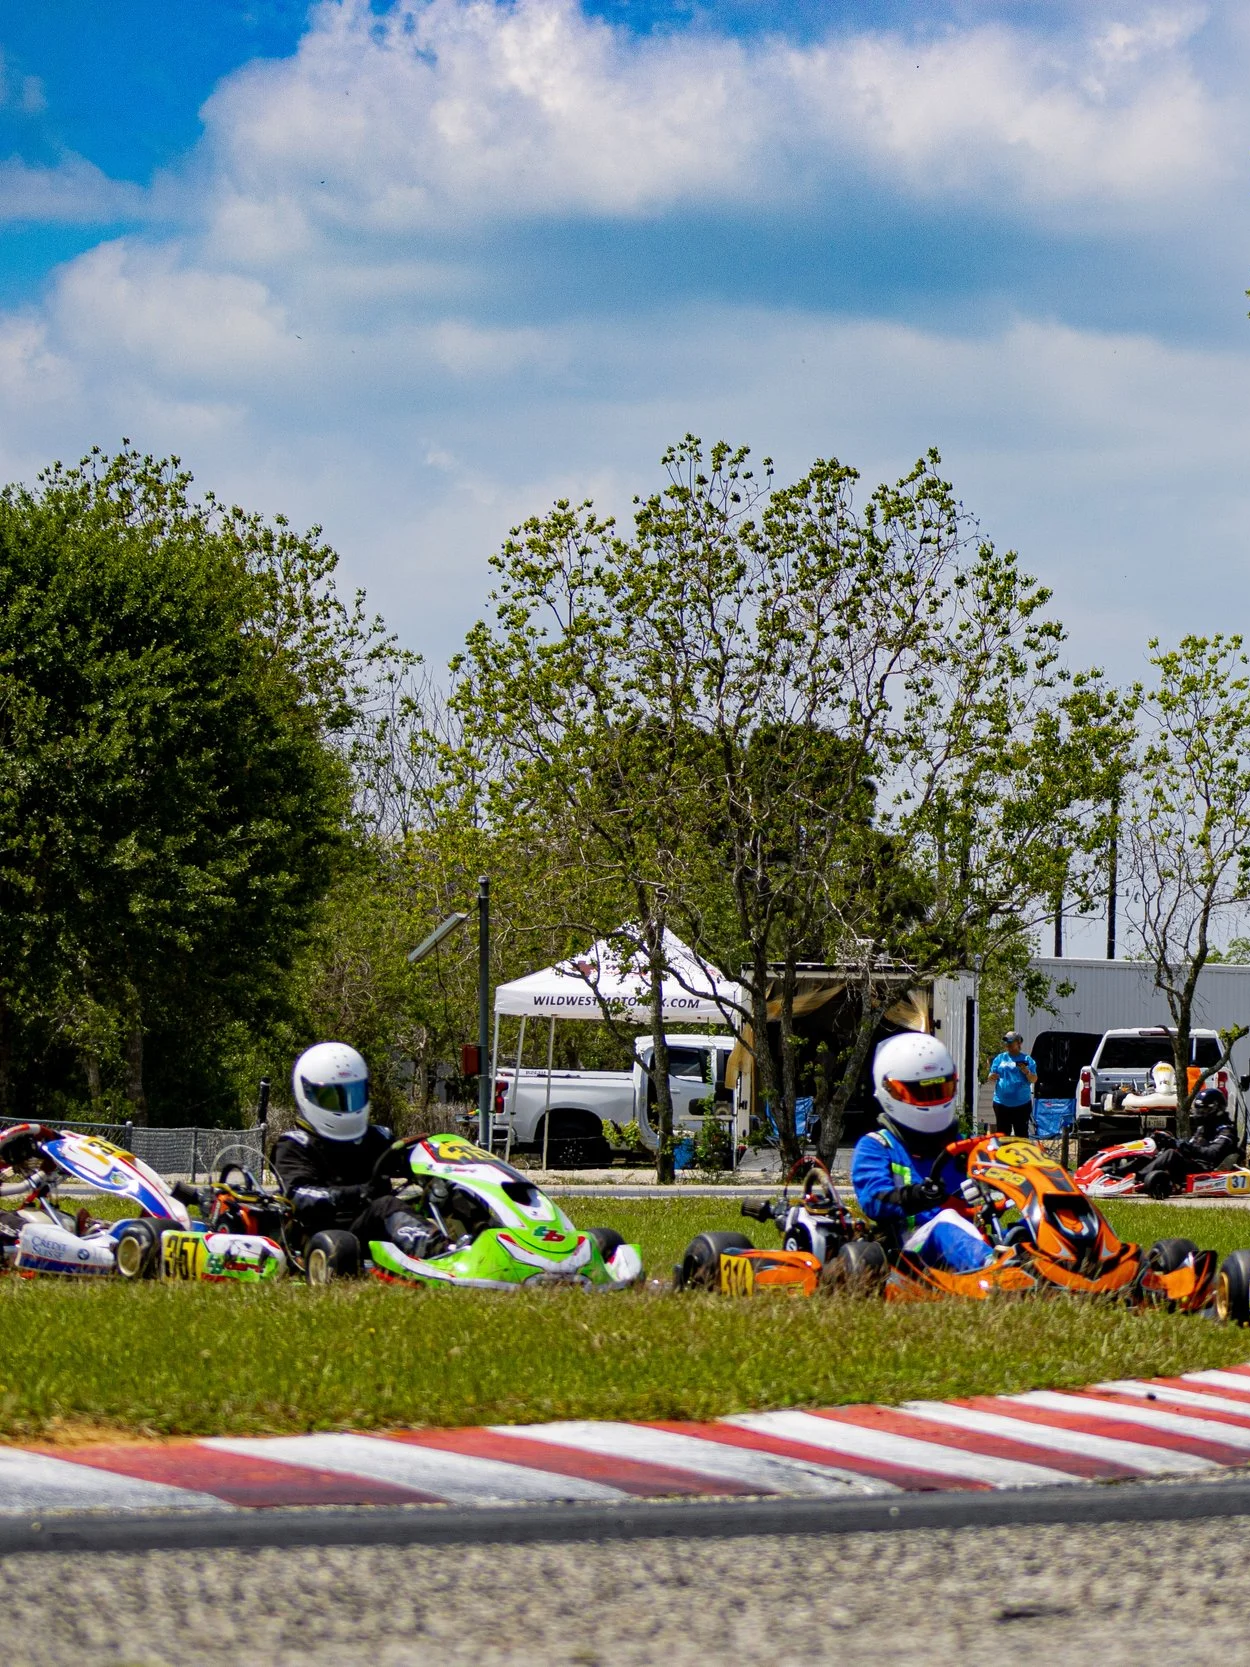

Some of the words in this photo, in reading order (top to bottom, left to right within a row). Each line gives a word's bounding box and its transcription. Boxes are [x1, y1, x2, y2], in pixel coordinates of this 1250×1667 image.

[533, 995, 700, 1009] WILDWESTMOTOX.COM
[1231, 1175, 1246, 1188] 37
[164, 1234, 200, 1280] 357
